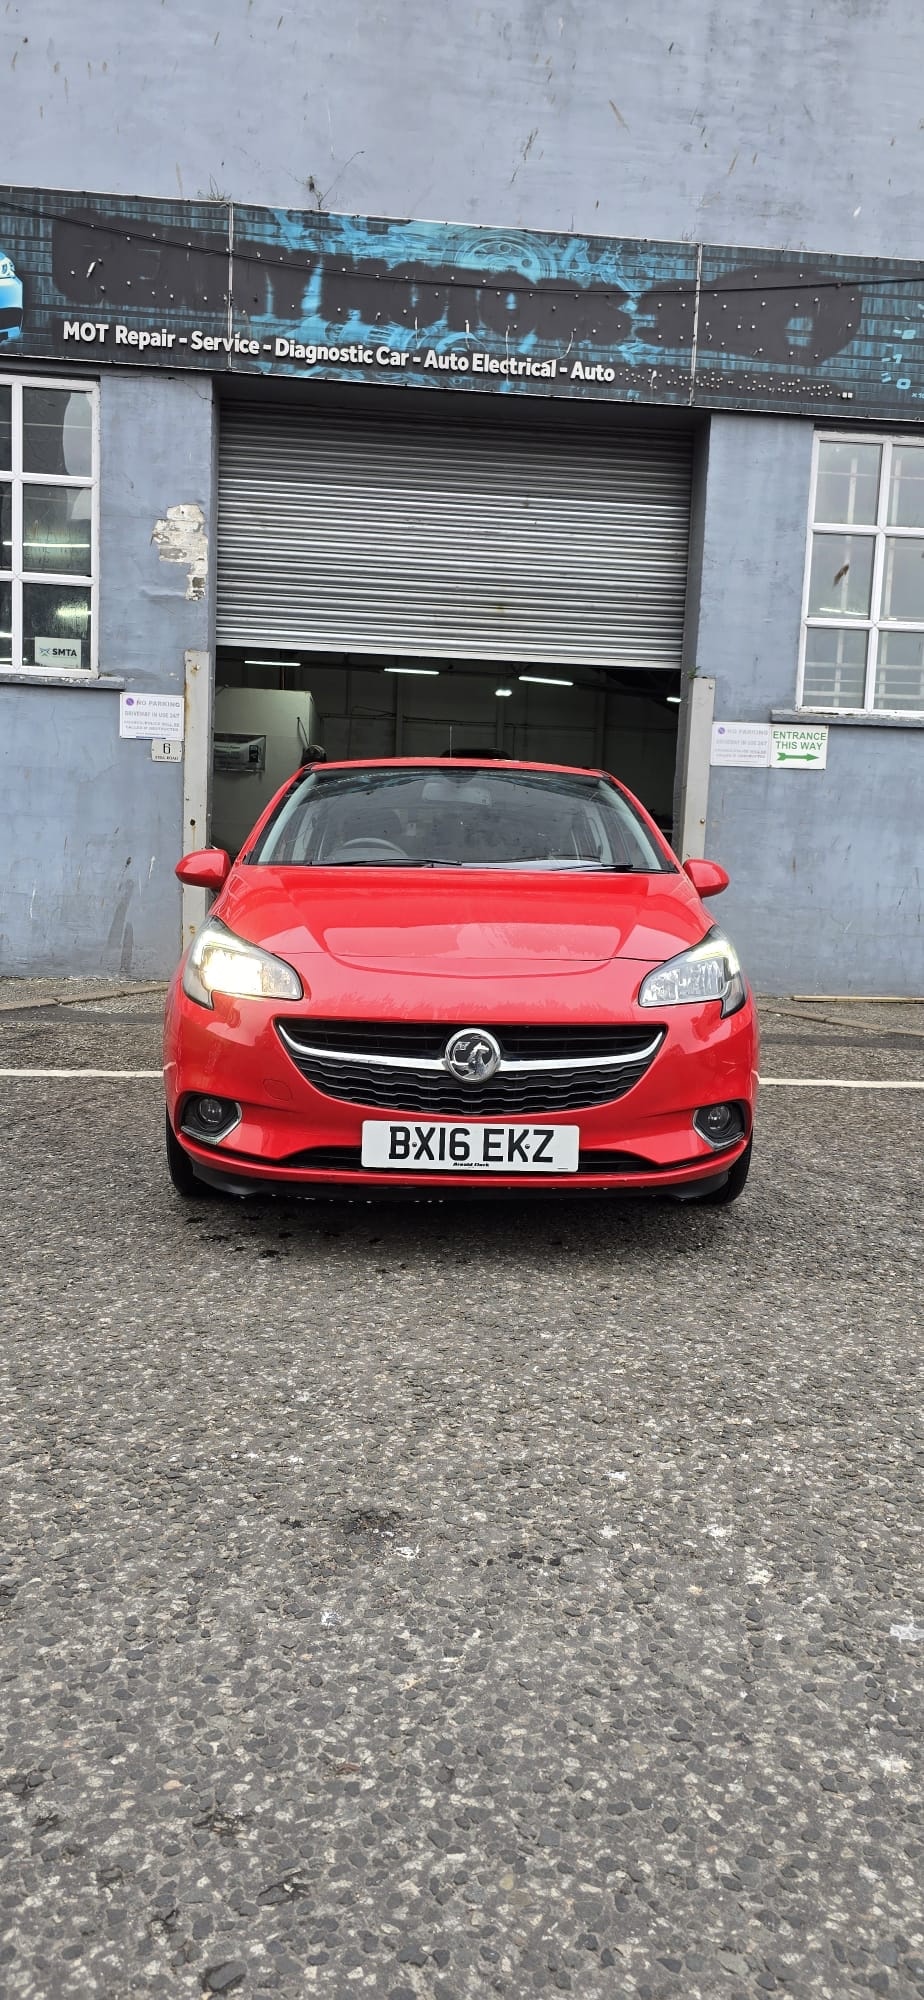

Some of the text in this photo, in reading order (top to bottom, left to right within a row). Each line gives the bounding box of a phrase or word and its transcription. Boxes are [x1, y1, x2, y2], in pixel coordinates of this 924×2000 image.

[63, 321, 109, 343] MOT
[115, 325, 176, 350] Repair
[190, 330, 260, 356] Service
[275, 338, 374, 364] Diagnostic
[376, 346, 410, 366] Car
[423, 349, 469, 371] Auto
[472, 353, 557, 379] Electrical
[570, 361, 615, 383] Auto
[52, 648, 77, 656] SMTA
[773, 730, 827, 741] ENTRANCE
[163, 742, 171, 754] 6
[776, 740, 798, 750] THIS
[800, 741, 823, 751] WAY
[388, 1126, 555, 1163] BX16 EKZ
